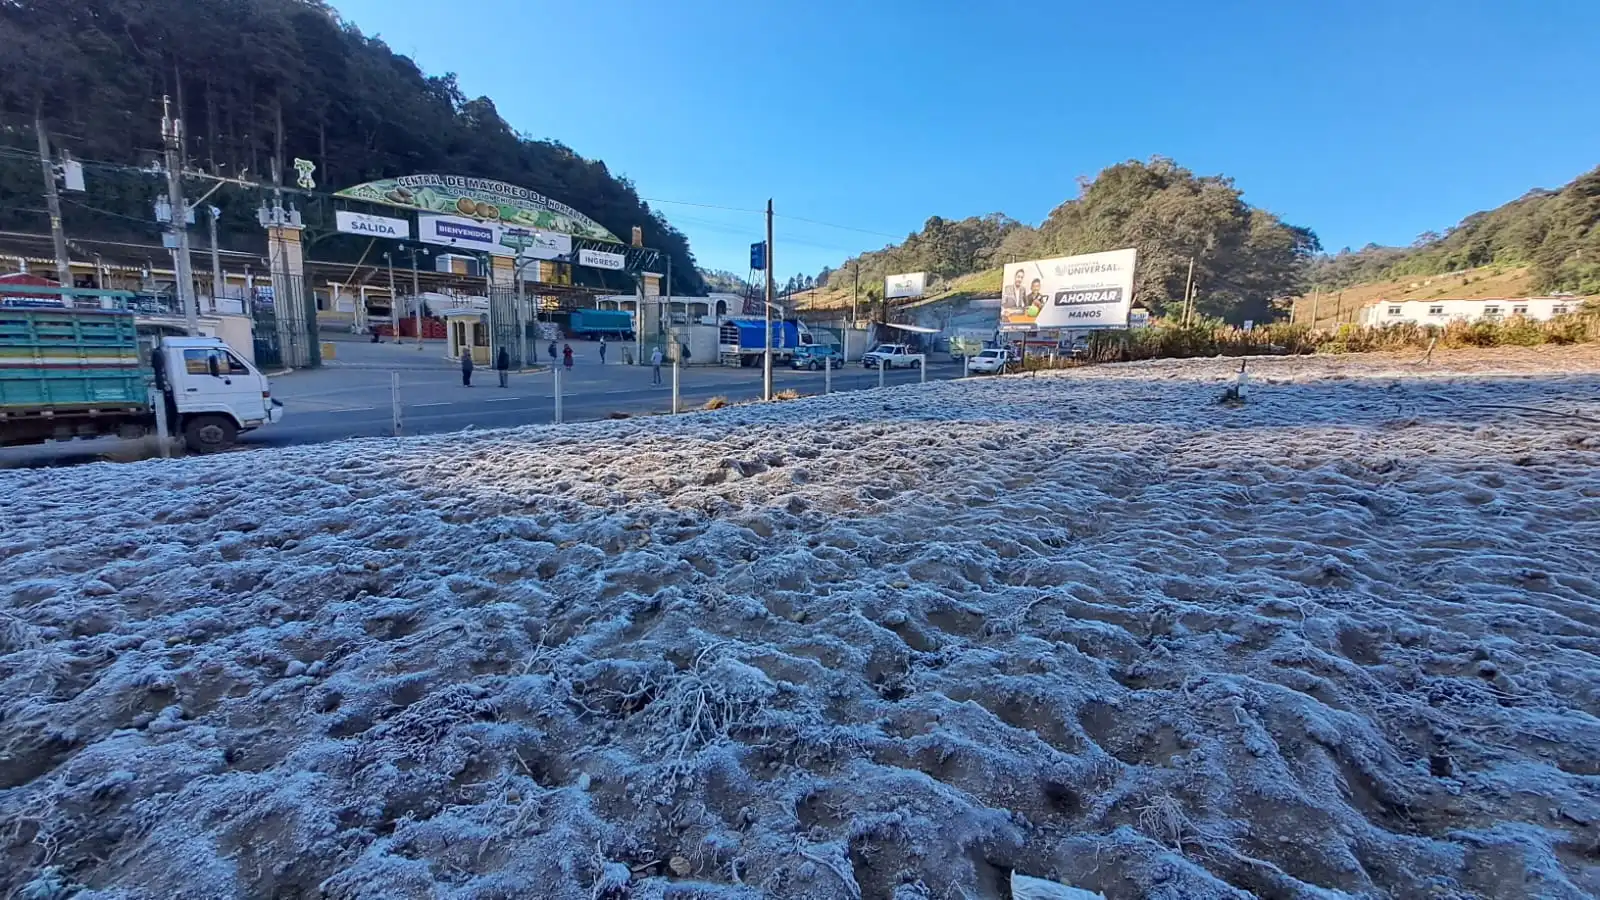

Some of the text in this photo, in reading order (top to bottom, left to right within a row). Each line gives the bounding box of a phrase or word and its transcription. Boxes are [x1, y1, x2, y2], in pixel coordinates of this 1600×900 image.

[398, 175, 593, 227] CENTRAL DE MAYOREO DE HORTALIZAS
[351, 221, 396, 235] SALIDA
[439, 225, 492, 240] BIENVENIDOS
[585, 256, 620, 268] INGRESO
[1068, 263, 1117, 275] UNIVERSAL
[1059, 290, 1117, 304] AHORRAR
[1068, 310, 1102, 319] MANOS
